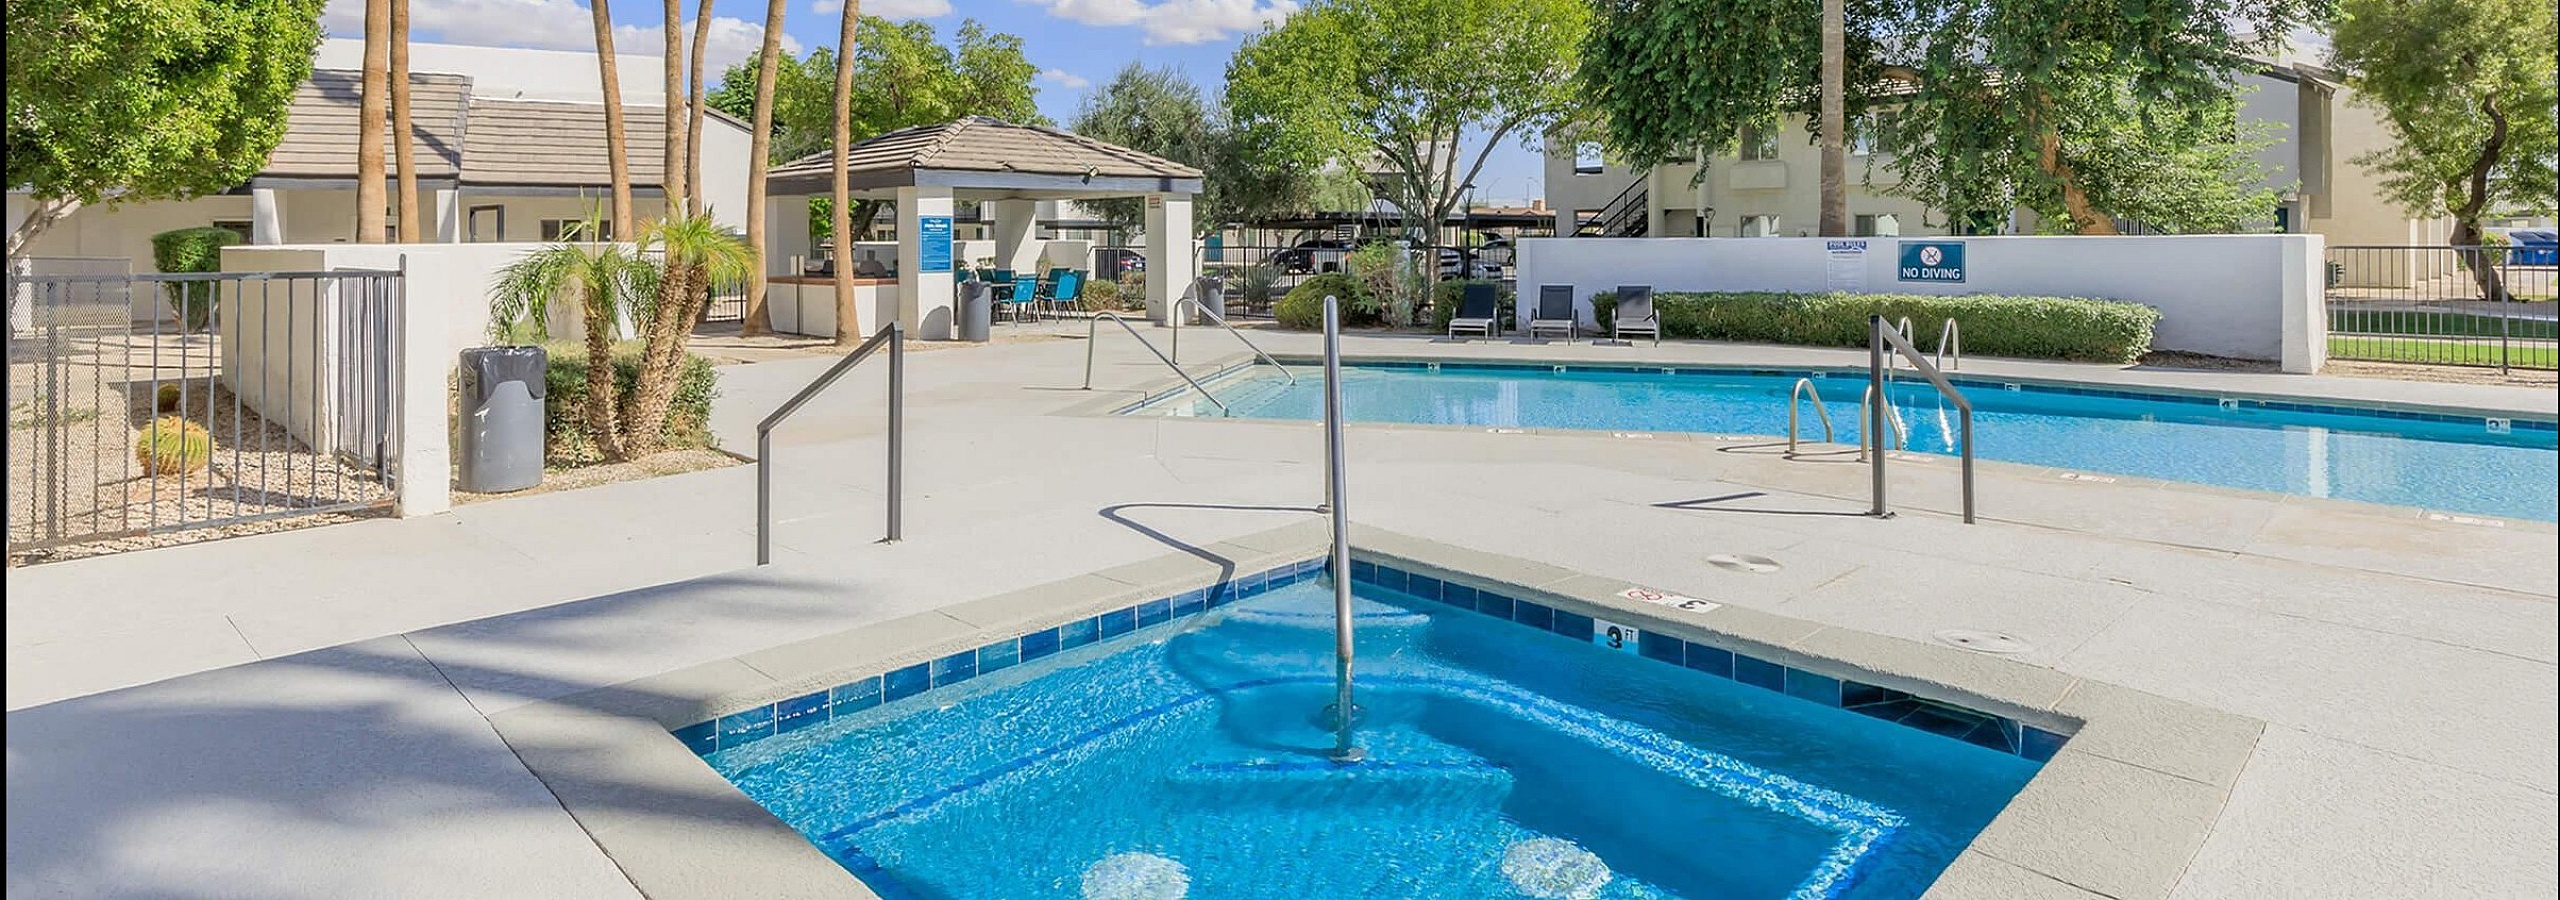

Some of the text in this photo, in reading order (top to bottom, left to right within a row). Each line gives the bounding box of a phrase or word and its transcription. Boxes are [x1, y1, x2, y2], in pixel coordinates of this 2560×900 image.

[1902, 267, 1961, 280] NO DIVING
[1606, 626, 1634, 649] 3 FT
